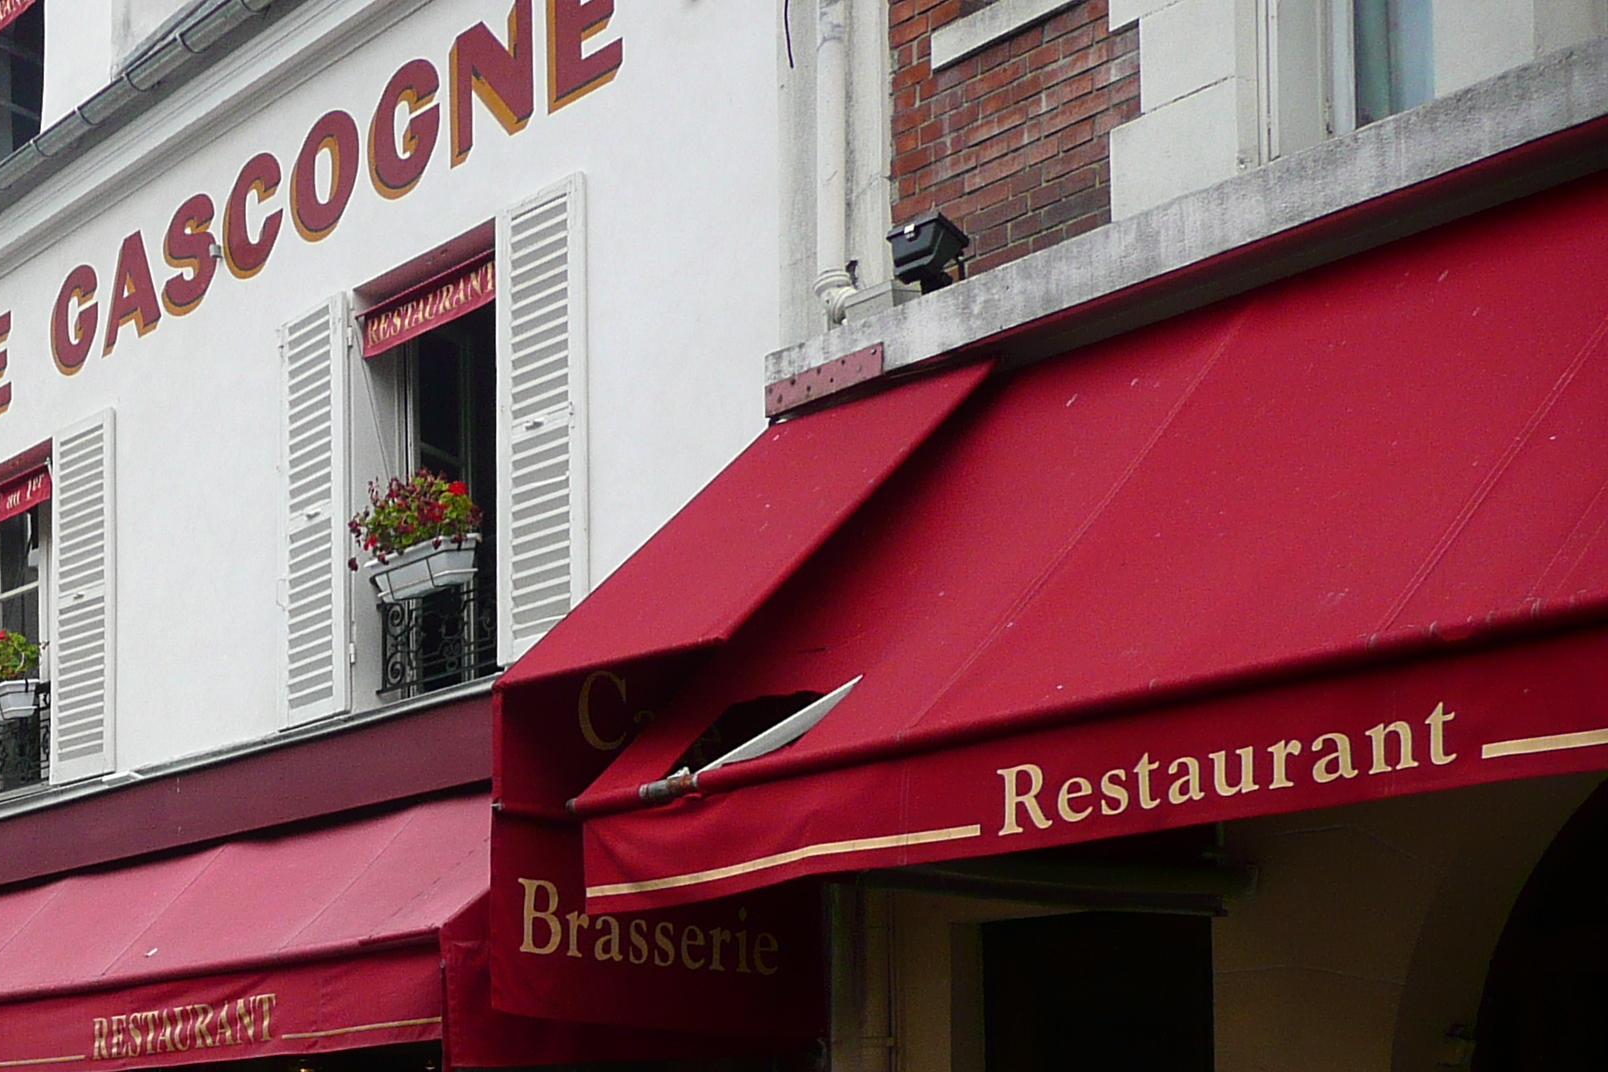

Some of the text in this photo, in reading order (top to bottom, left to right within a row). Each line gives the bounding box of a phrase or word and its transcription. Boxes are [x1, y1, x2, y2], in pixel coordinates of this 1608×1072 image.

[50, 0, 623, 376] GASCOGNE
[367, 261, 496, 348] RESTAURANT
[6, 490, 21, 510] au
[26, 473, 45, 501] 1er
[996, 701, 1458, 837] Restaurant
[517, 877, 780, 976] Brasserie
[93, 993, 276, 1060] RESTAURANT
